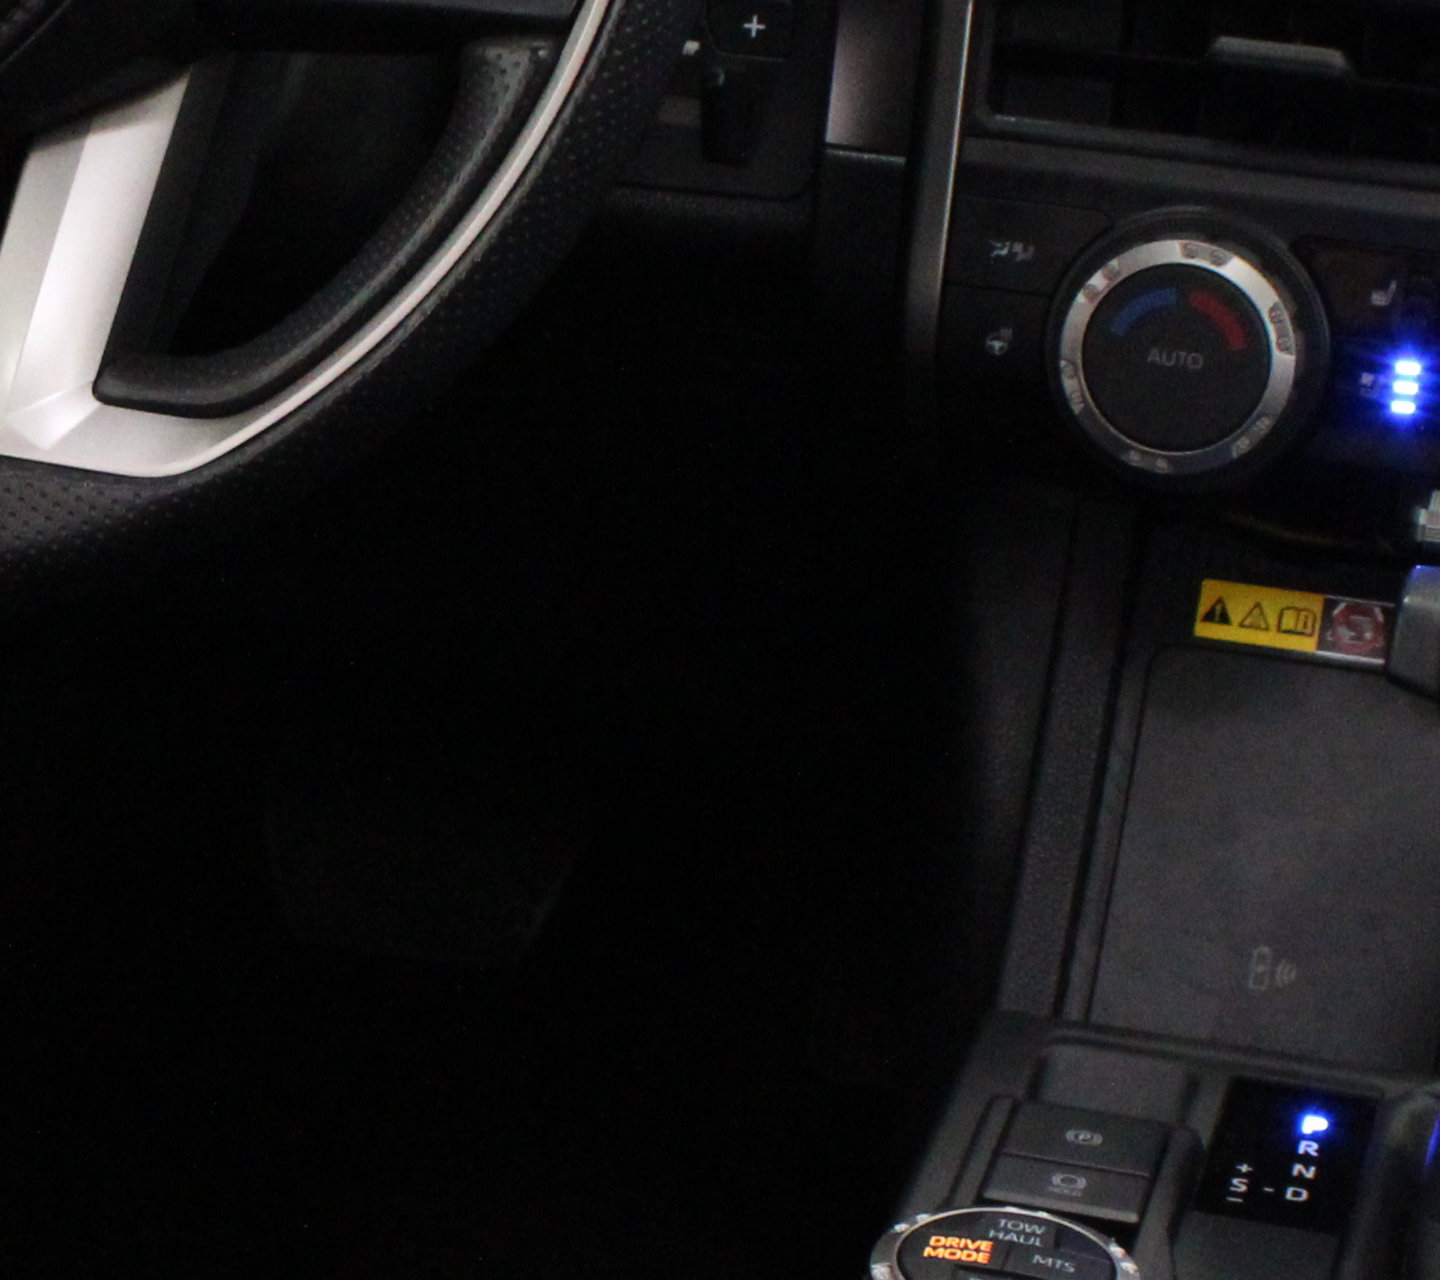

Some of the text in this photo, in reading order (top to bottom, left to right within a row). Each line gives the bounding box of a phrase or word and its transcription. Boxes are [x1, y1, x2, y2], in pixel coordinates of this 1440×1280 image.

[1147, 346, 1203, 370] AUTO
[1298, 1140, 1319, 1157] R
[1292, 1163, 1316, 1180] N
[1285, 1187, 1310, 1202] D
[998, 1218, 1047, 1236] TOW
[929, 1235, 994, 1253] DRIVE
[988, 1228, 1042, 1248] HAUL
[923, 1246, 992, 1264] MODE
[1032, 1253, 1075, 1274] MTS
